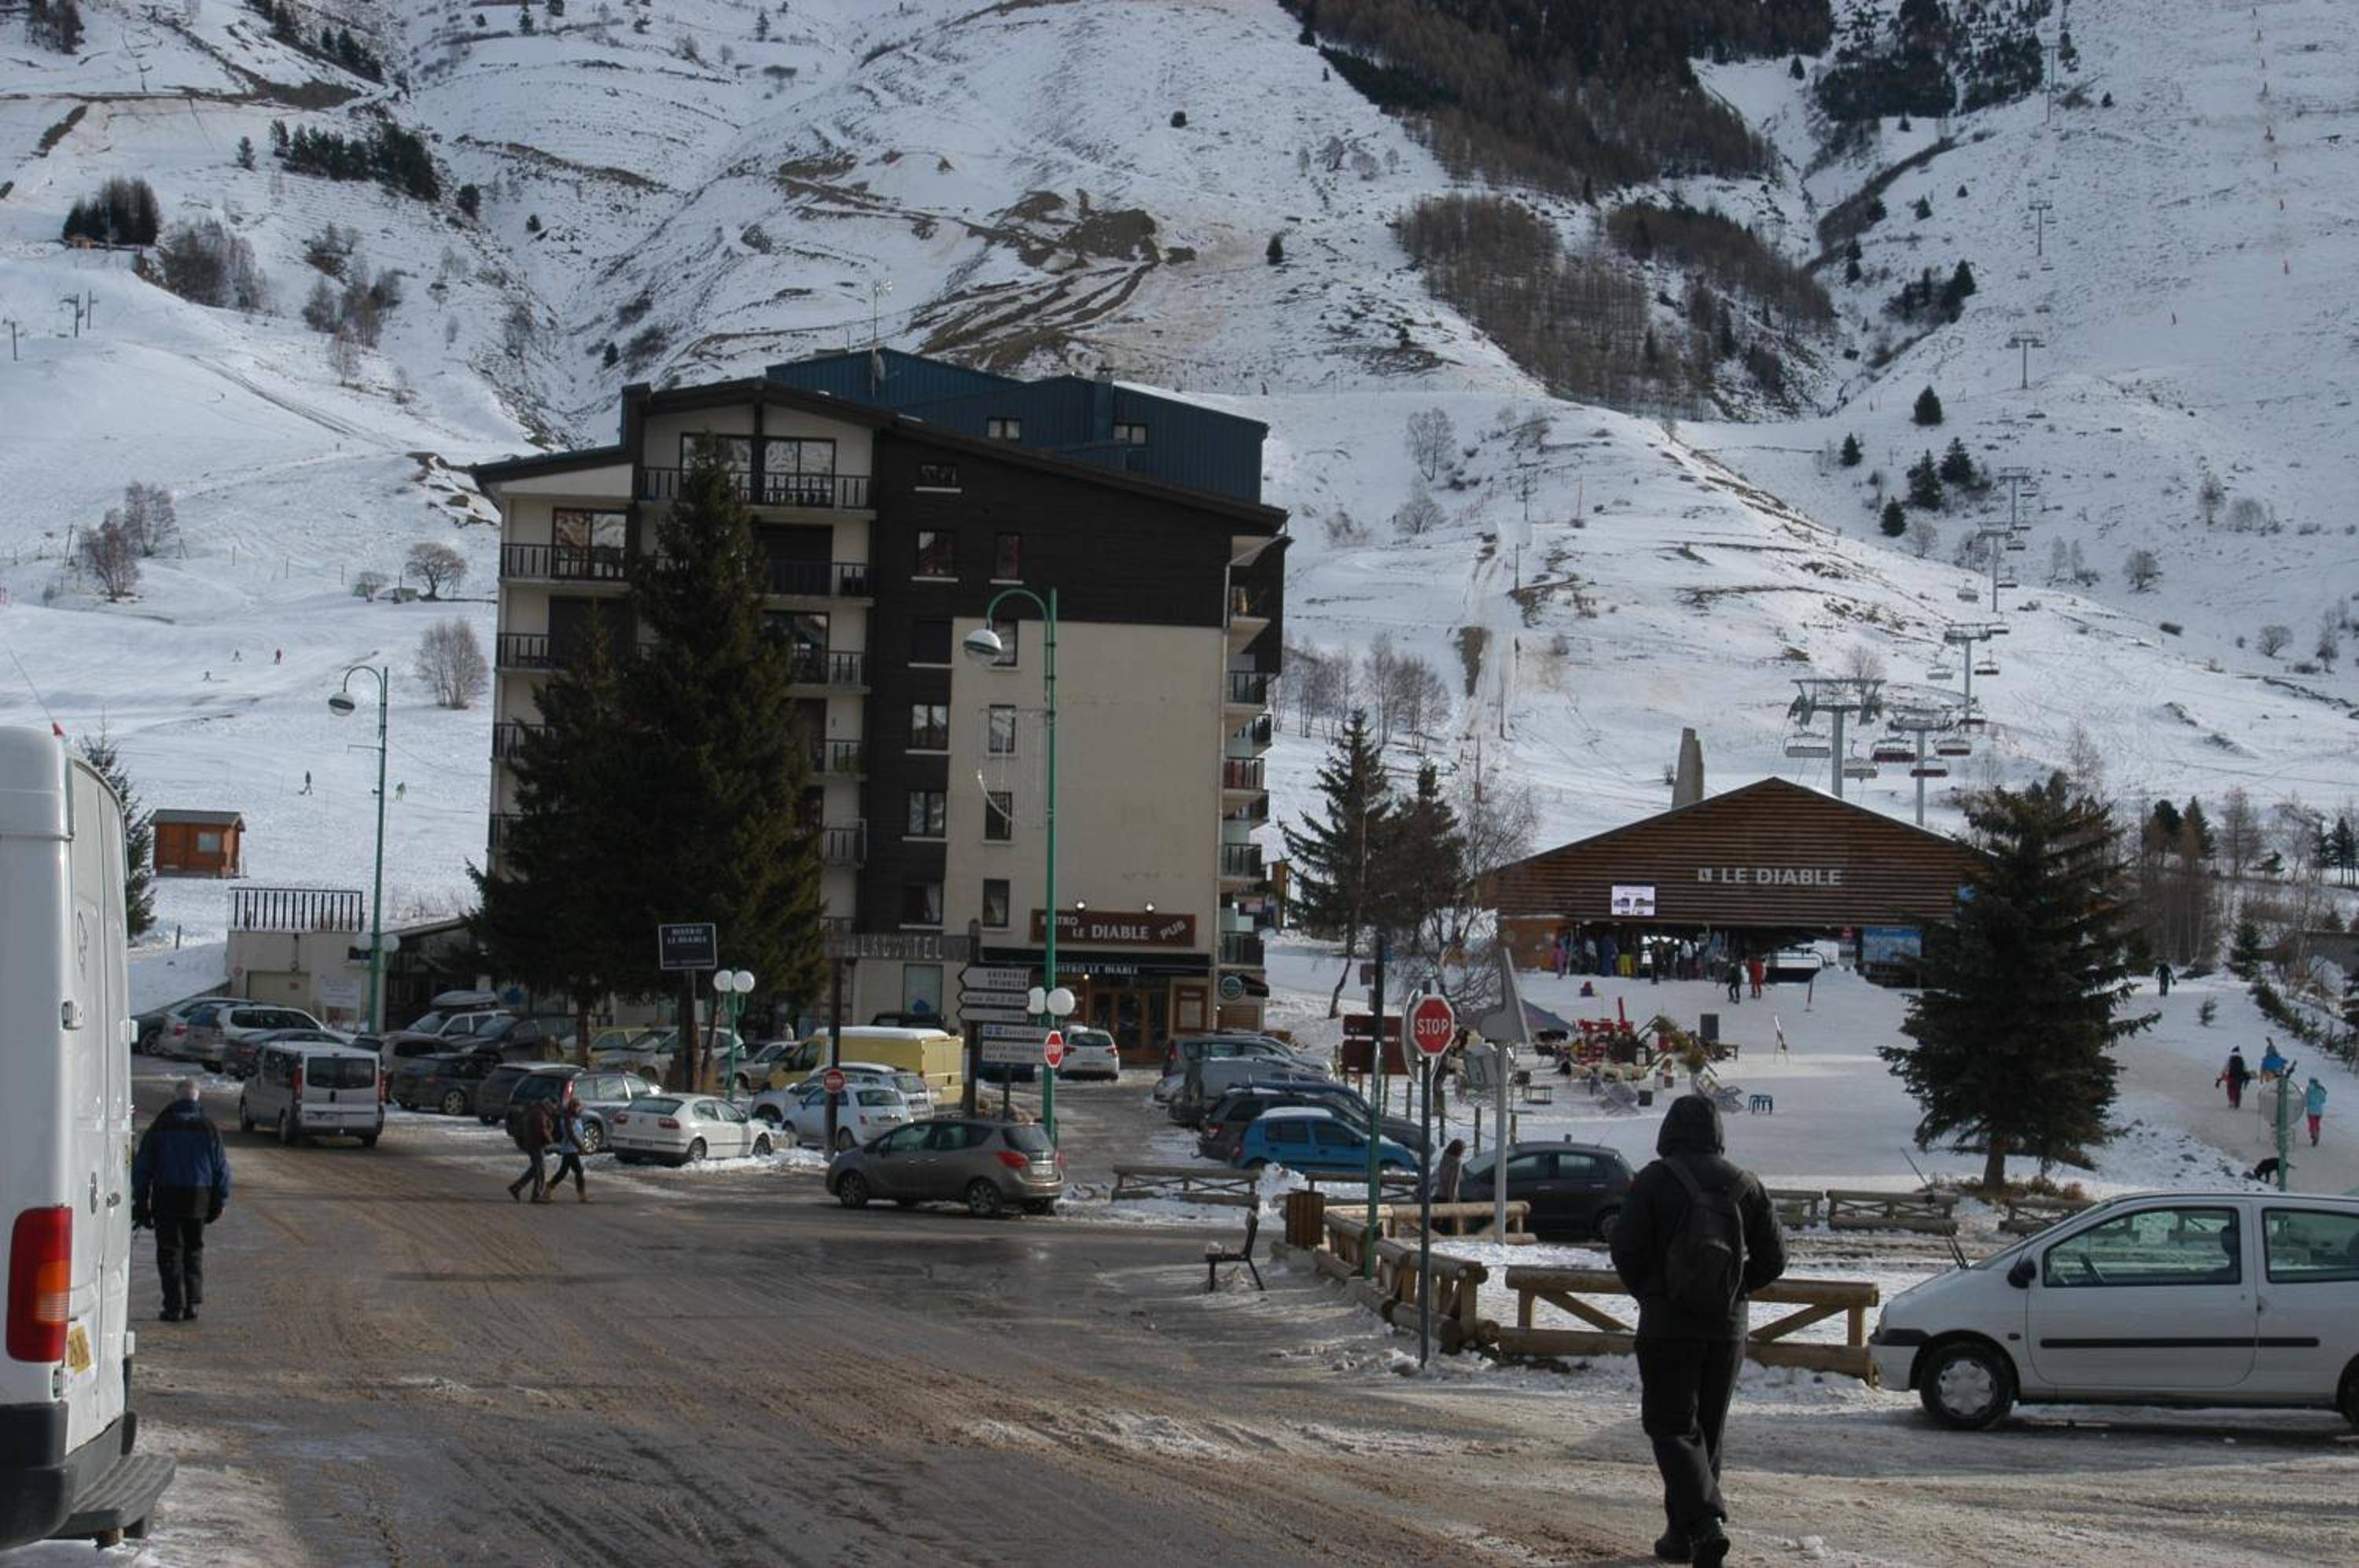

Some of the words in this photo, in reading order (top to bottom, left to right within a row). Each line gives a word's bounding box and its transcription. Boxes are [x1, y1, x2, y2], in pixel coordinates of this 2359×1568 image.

[1721, 868, 1747, 884] LE
[1756, 868, 1843, 886] DIABLE
[1072, 928, 1084, 938] LE
[1091, 924, 1150, 940] DIABLE
[1159, 919, 1187, 940] PUB
[1104, 964, 1139, 976] DIABLE
[1416, 1018, 1449, 1036] STOP
